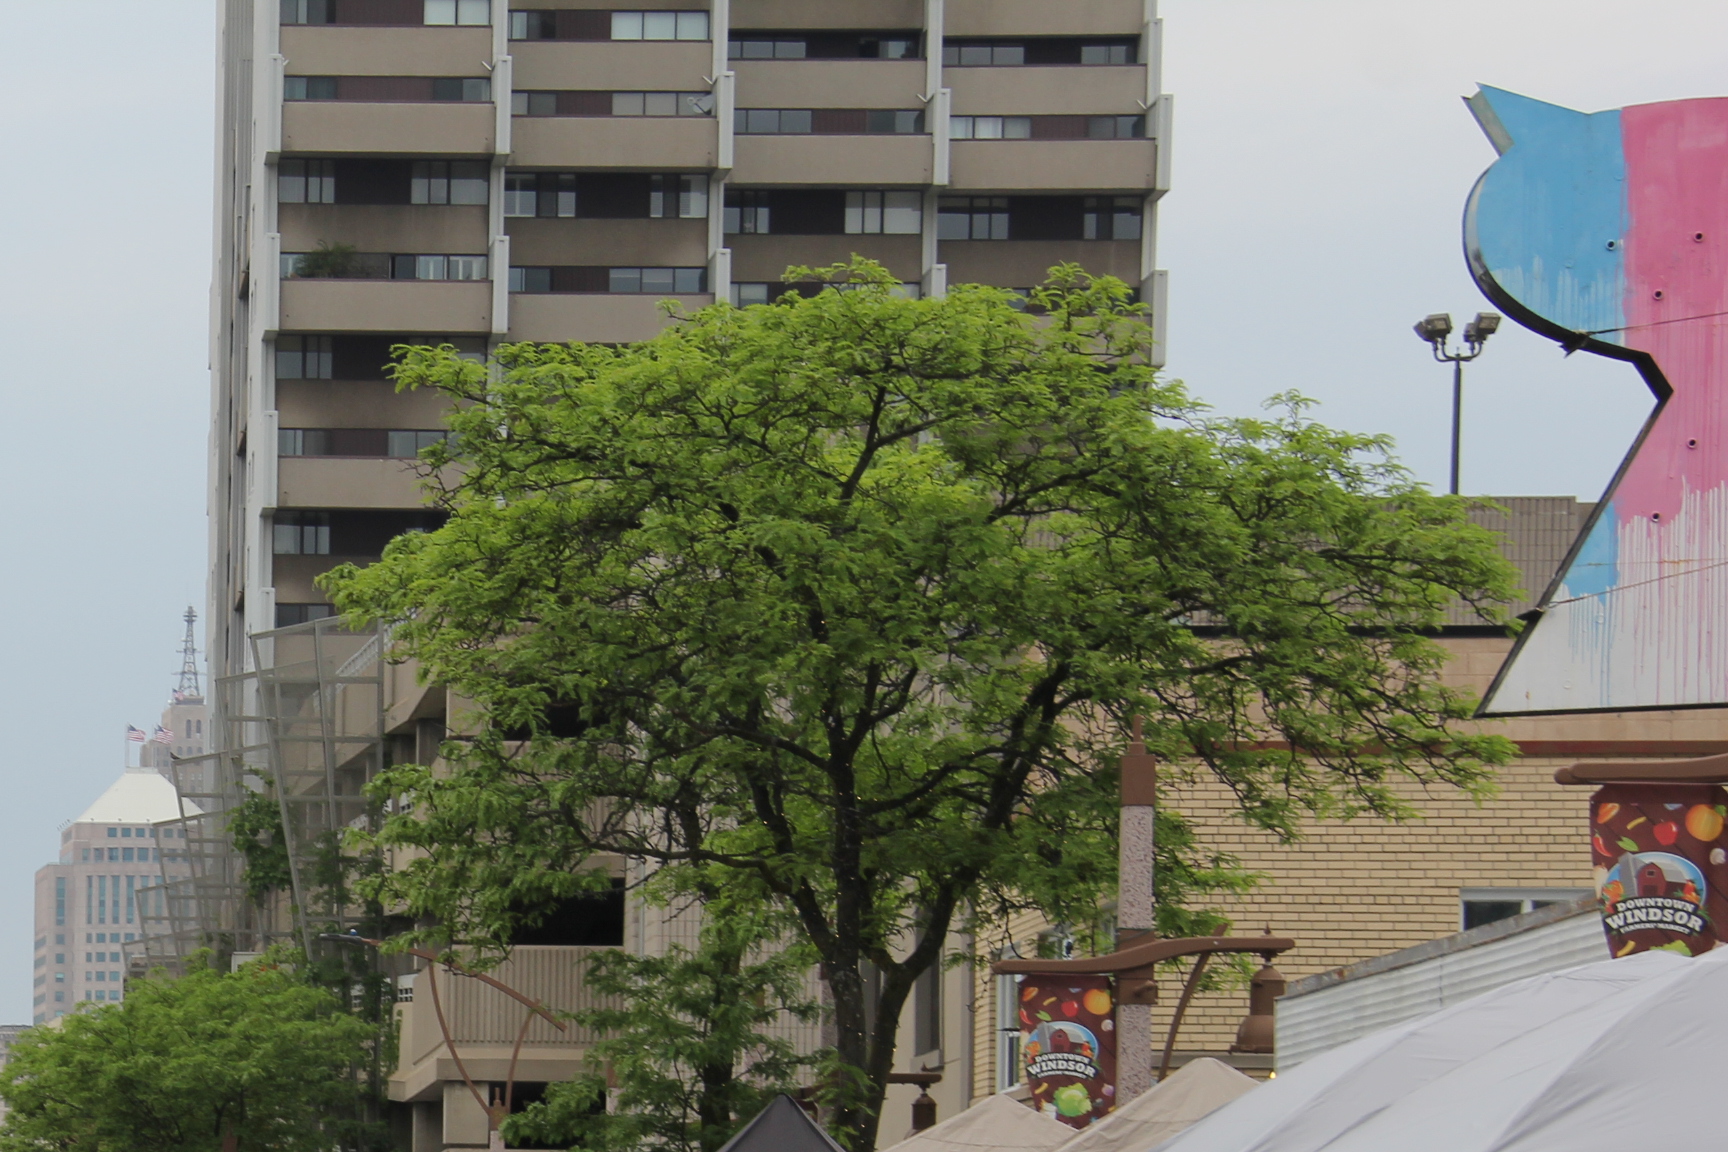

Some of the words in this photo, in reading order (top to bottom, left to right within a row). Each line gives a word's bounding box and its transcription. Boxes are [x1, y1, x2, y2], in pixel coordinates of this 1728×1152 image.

[1616, 897, 1696, 912] DOWNTOWN
[1605, 907, 1703, 932] WINDSOR
[1034, 1053, 1091, 1064] DOWNTOWN
[1027, 1060, 1096, 1078] WINDSOR
